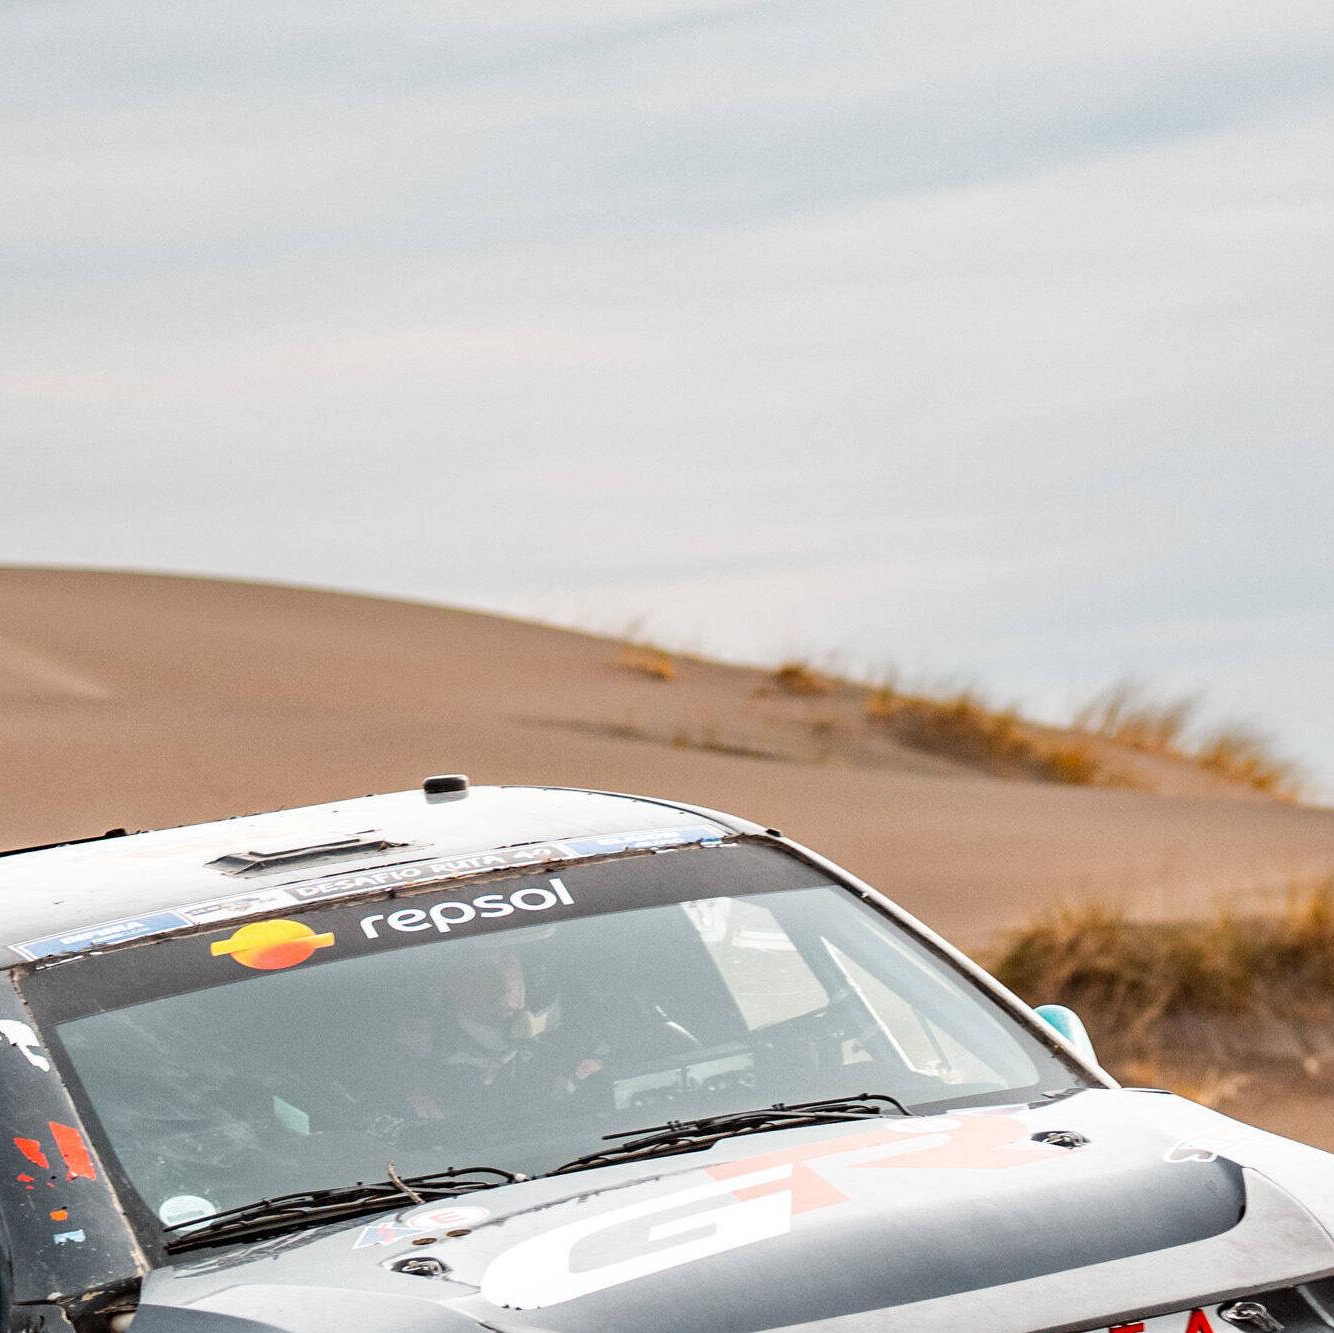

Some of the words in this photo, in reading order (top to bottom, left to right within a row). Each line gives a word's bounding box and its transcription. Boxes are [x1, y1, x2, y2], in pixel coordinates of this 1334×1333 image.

[296, 866, 423, 898] DESAFIO
[431, 854, 505, 874] RUTA
[360, 878, 575, 939] repsol
